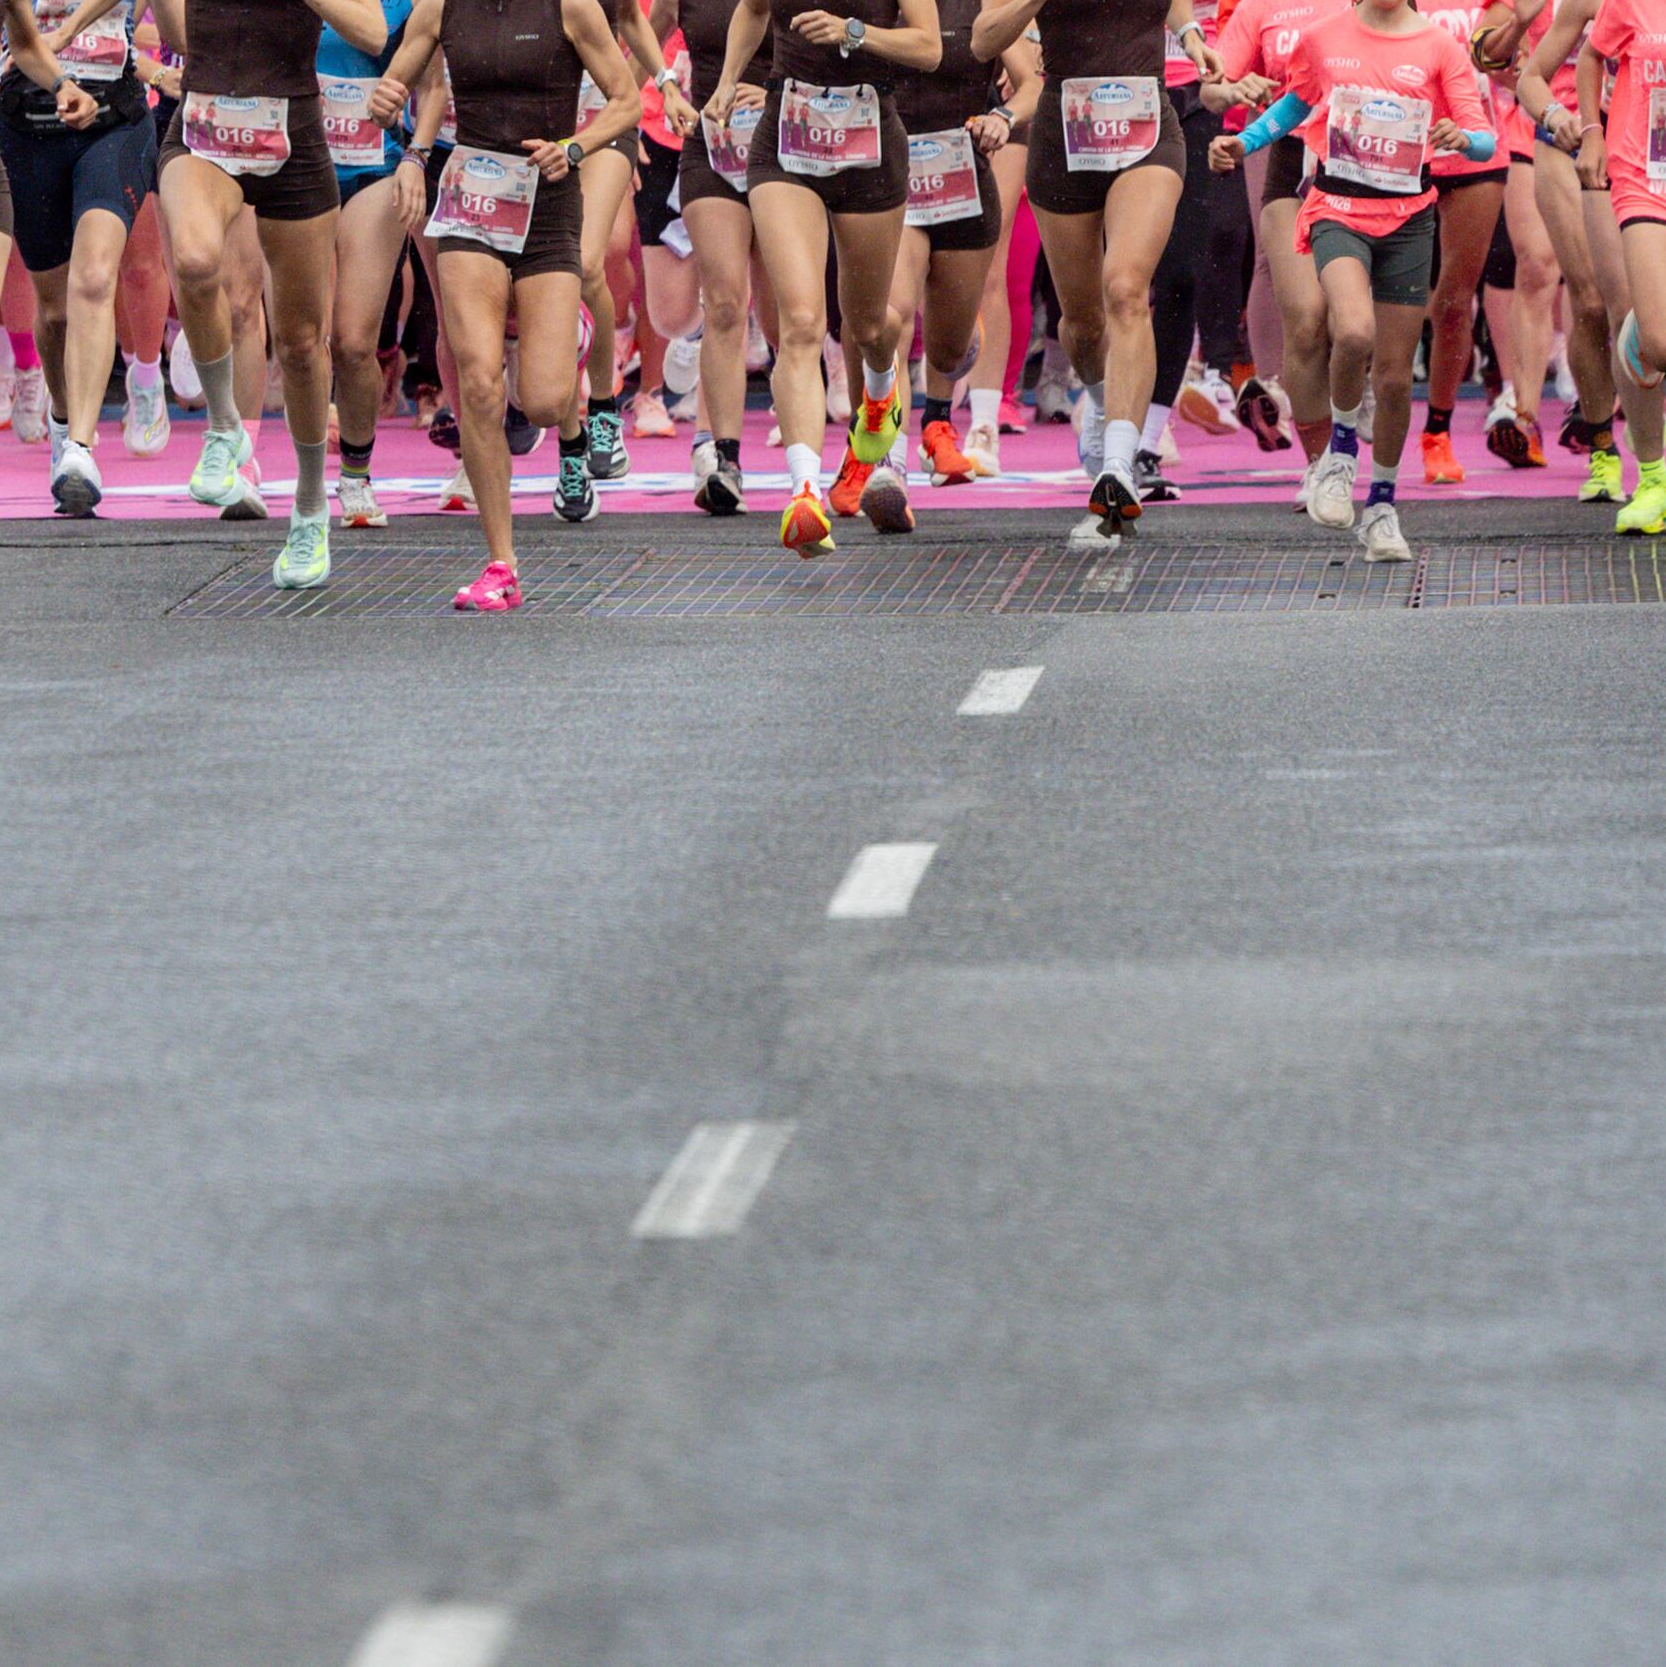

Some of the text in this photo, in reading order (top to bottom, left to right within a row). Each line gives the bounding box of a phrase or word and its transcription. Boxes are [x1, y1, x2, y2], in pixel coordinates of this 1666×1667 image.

[1273, 6, 1314, 21] OYSHO
[323, 116, 360, 135] 016
[1094, 120, 1131, 137] 016
[215, 127, 255, 144] 016
[809, 128, 846, 145] 016
[1357, 135, 1398, 156] 016
[910, 174, 945, 193] 016
[461, 193, 497, 214] 016
